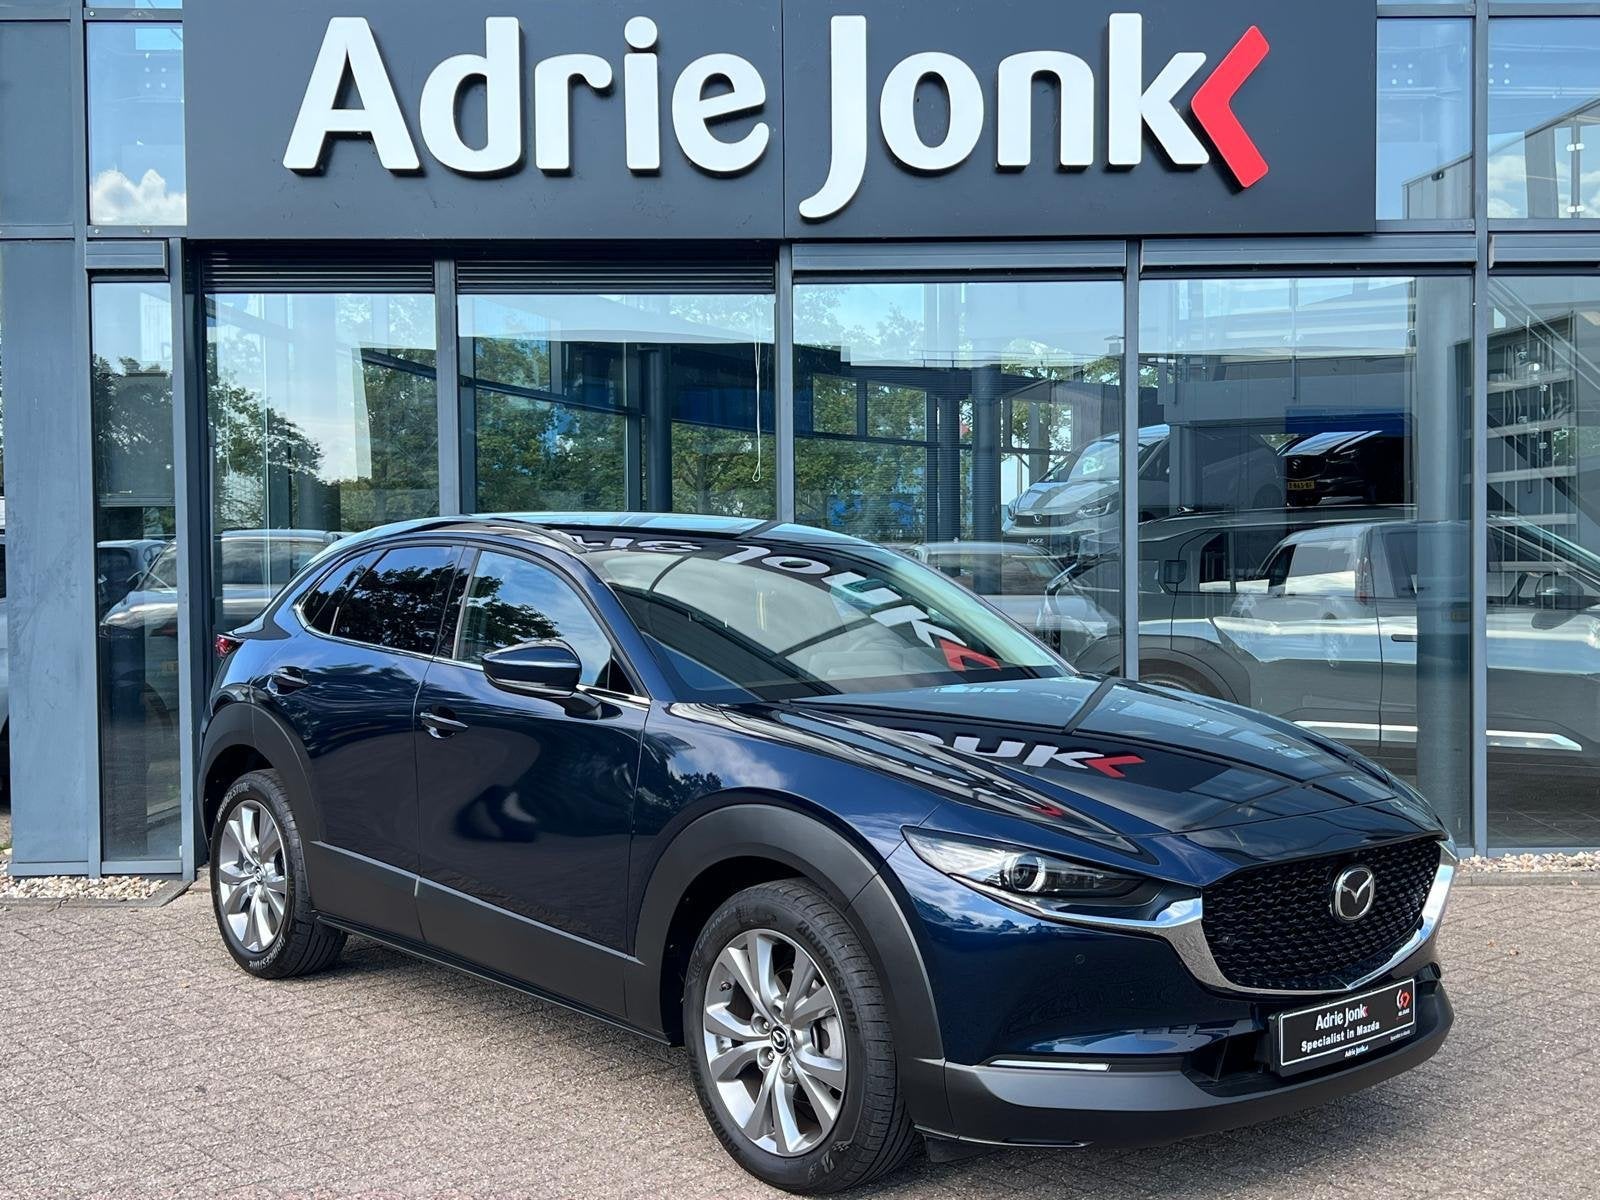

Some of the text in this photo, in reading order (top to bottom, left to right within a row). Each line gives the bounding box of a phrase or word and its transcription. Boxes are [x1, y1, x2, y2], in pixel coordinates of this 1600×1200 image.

[282, 12, 1211, 219] Adrie Jonk
[1315, 1004, 1366, 1030] Adrie Jonk
[1301, 1031, 1345, 1053] Specialist
[1346, 1029, 1355, 1039] in
[1356, 1021, 1380, 1036] Mazda
